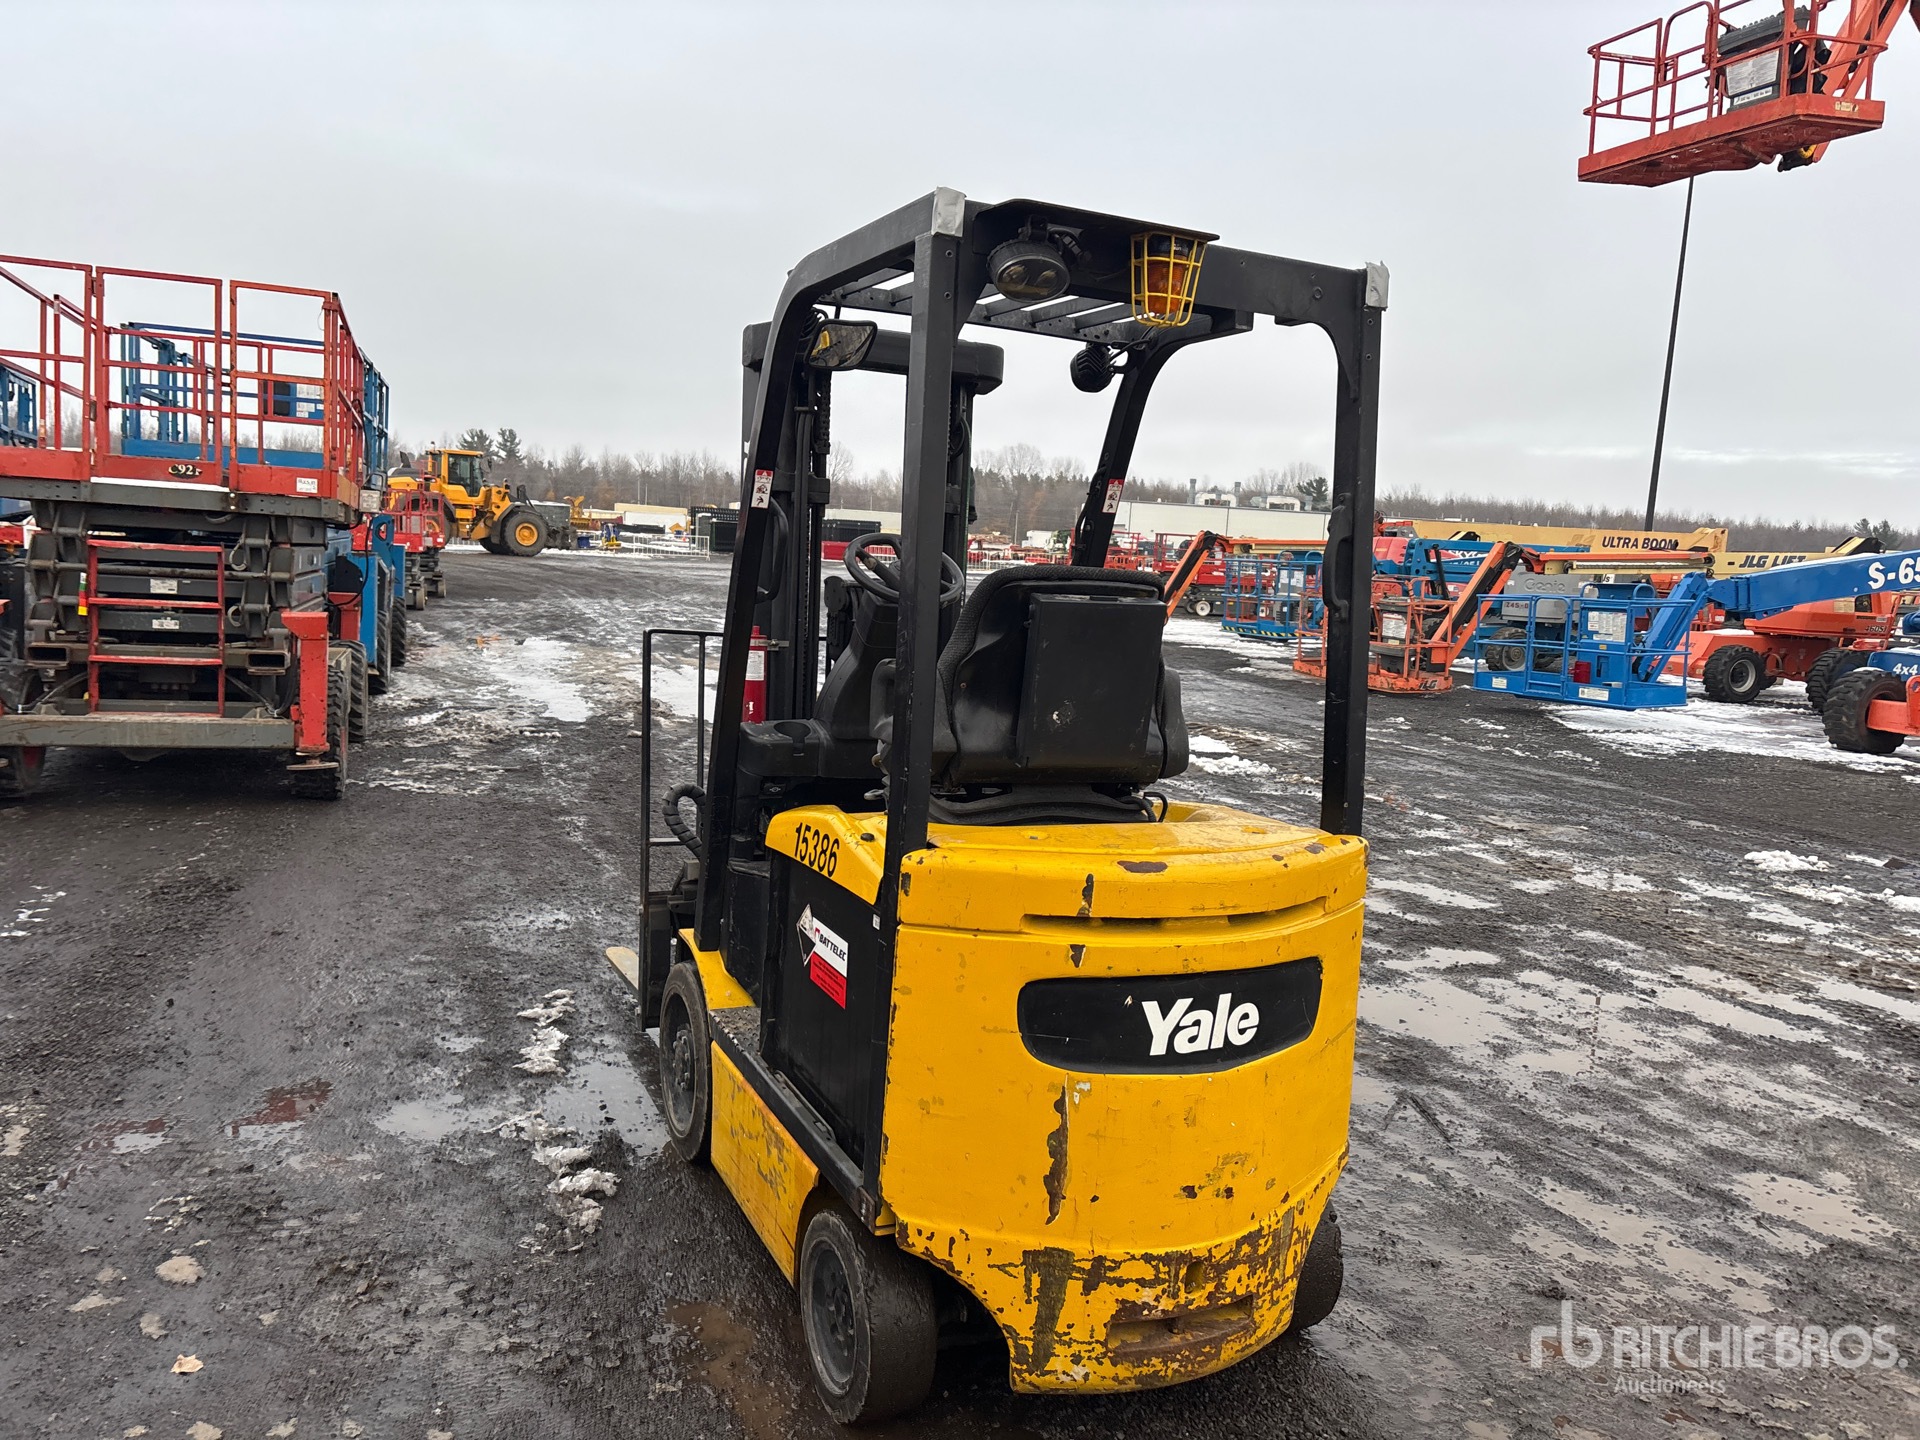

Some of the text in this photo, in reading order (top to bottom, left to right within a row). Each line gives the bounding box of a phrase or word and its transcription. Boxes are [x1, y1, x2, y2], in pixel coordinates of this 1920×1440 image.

[1602, 536, 1639, 549] ULTRA
[1739, 555, 1768, 568] JLG
[1525, 578, 1565, 593] Genie
[1893, 663, 1918, 676] 4x4
[794, 822, 839, 878] 15386
[819, 933, 847, 962] BATTELEC
[1141, 993, 1260, 1056] Yale
